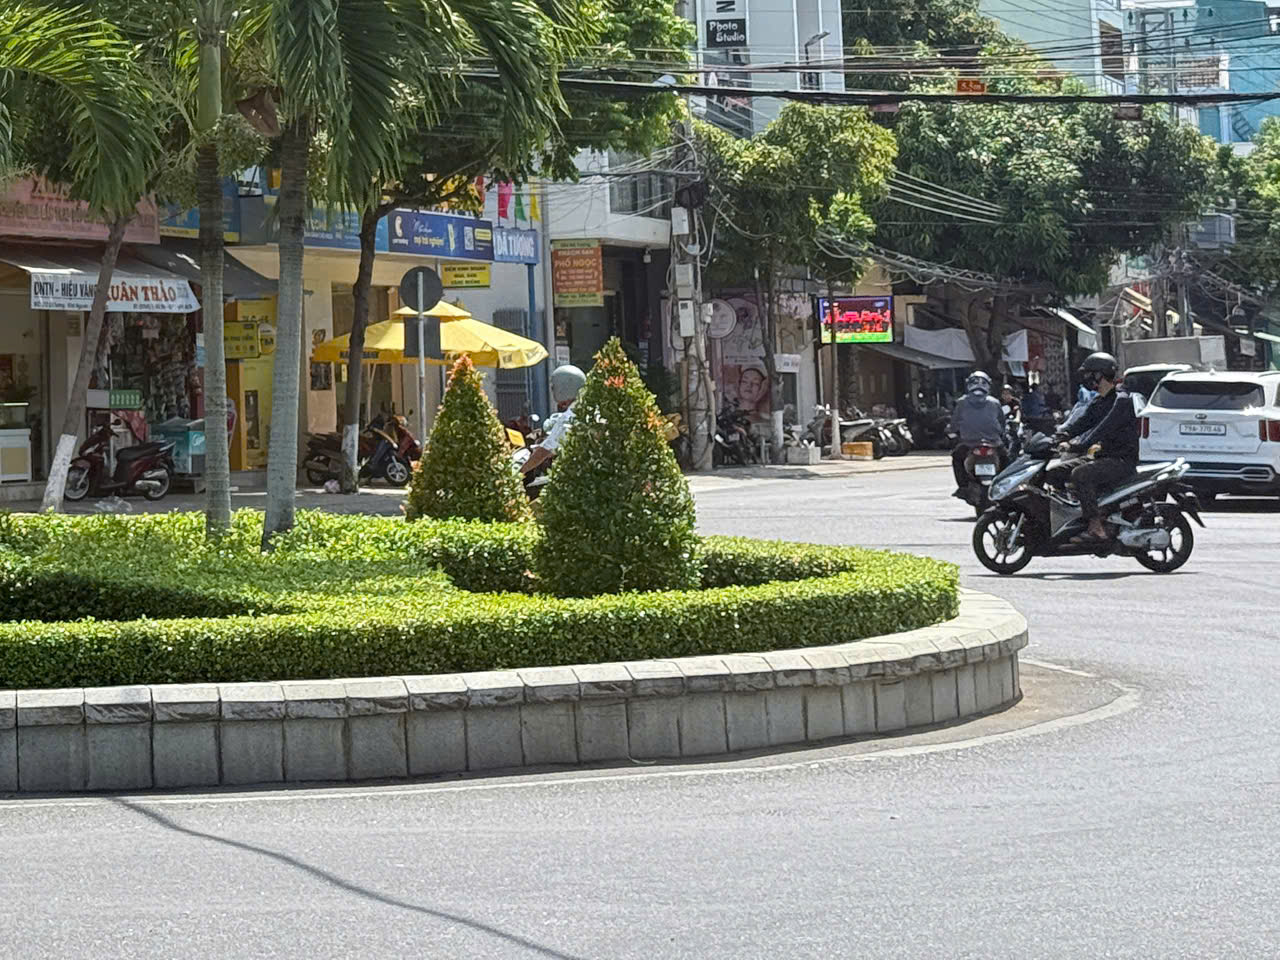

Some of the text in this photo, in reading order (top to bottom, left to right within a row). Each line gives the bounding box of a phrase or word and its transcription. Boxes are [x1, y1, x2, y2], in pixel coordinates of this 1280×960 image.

[709, 21, 738, 32] Photo
[715, 31, 745, 42] Studio
[140, 280, 177, 302] THẢO
